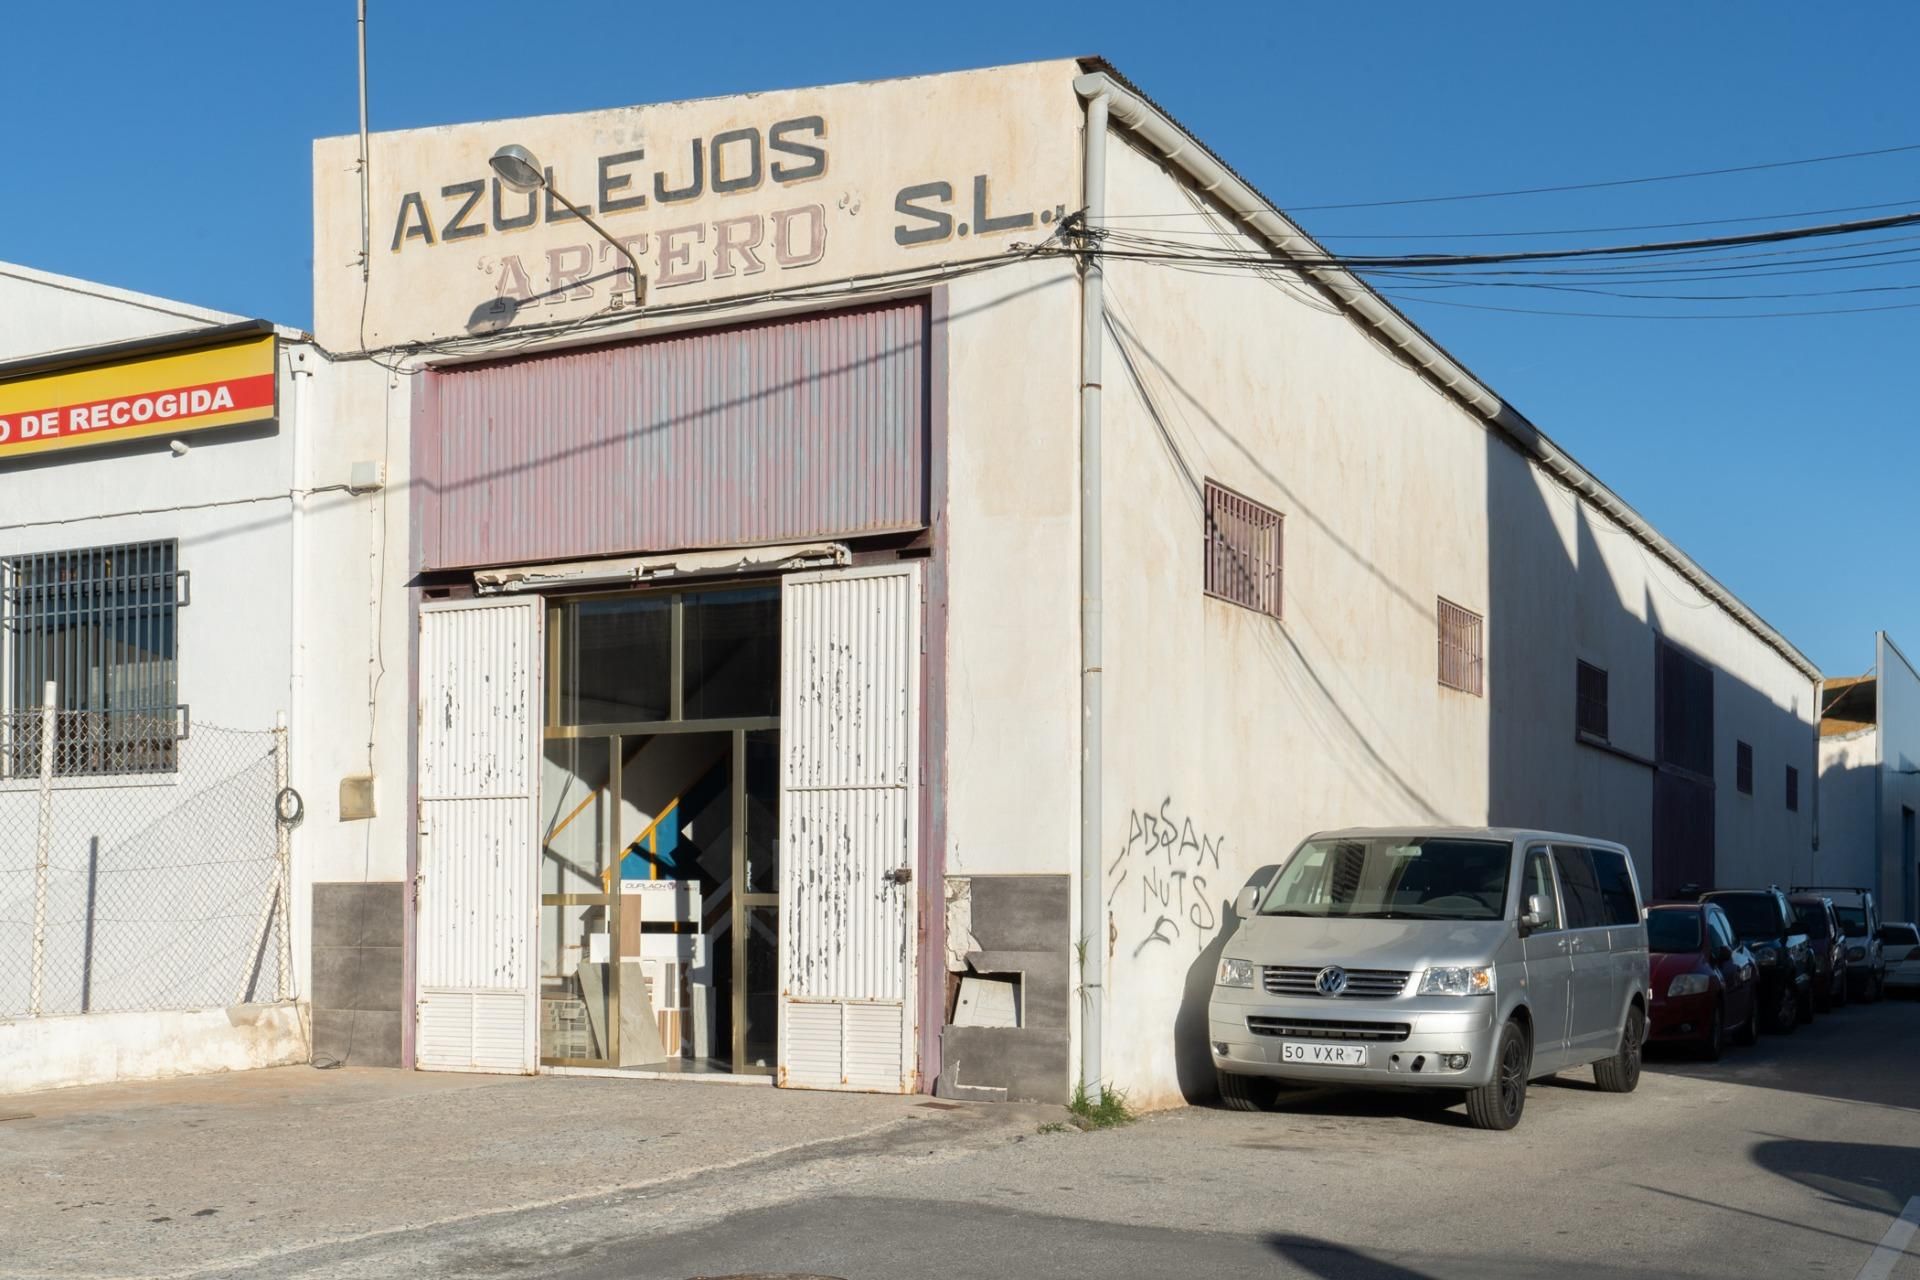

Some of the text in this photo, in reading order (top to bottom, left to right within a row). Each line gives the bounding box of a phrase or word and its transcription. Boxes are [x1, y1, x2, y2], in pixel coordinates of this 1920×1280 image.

[390, 115, 829, 253] AZULEJOS
[894, 173, 1053, 247] S.L.
[20, 411, 60, 438] DE
[69, 385, 235, 431] RECOGIDA
[1284, 1045, 1364, 1064] 50 VXR 7
